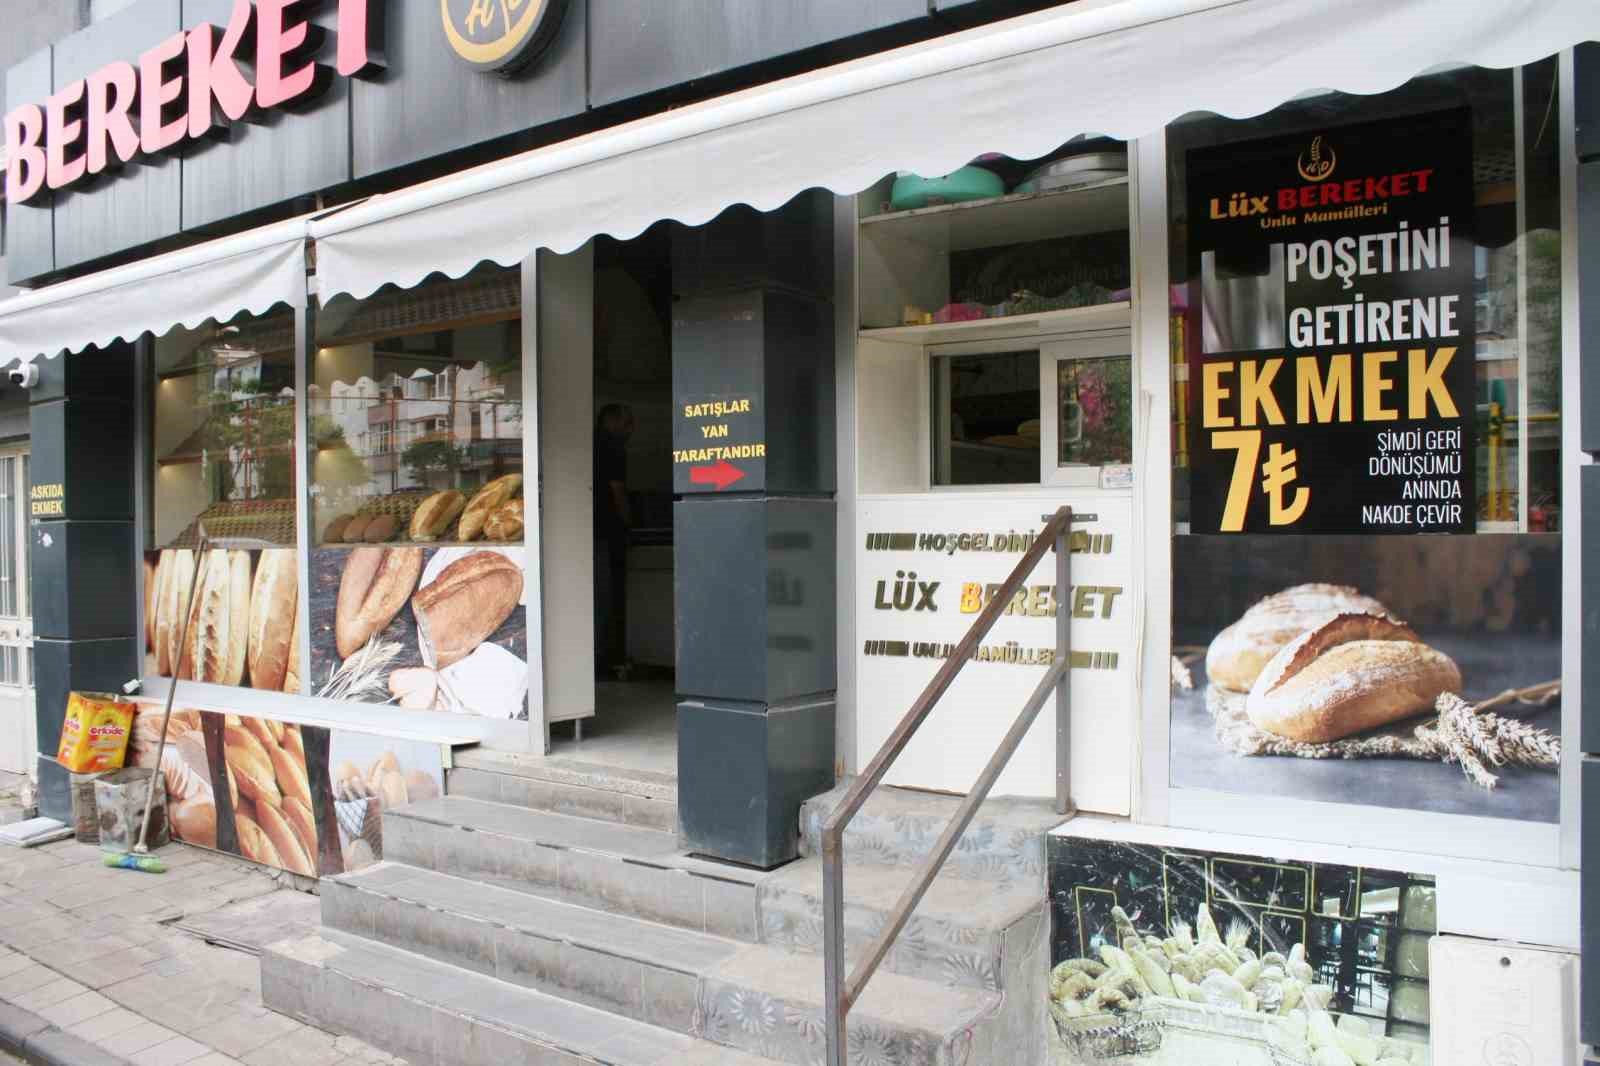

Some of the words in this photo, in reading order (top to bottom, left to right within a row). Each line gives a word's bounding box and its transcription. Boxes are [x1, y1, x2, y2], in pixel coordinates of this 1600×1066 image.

[1209, 192, 1269, 219] Lüx
[1277, 168, 1433, 211] BEREKET
[1260, 214, 1297, 229] Unlu
[1303, 202, 1388, 225] Mamülleri
[1287, 216, 1450, 289] POŞETİNİ
[1289, 293, 1460, 348] GETİRENE
[1202, 347, 1460, 428] EKMEK
[685, 400, 750, 418] SATIŞLAR
[702, 424, 728, 438] YAN
[1377, 428, 1421, 454] ŞİMDİ
[1425, 427, 1461, 450] GERİ
[673, 444, 765, 463] TARAFTANDIR
[1369, 451, 1461, 478] DÖNÜŞÜMÜ
[1402, 480, 1462, 499] ANINDA
[1362, 504, 1412, 525] NAKDE
[1417, 501, 1461, 527] ÇEVİR
[918, 529, 1044, 555] HOŞGELDİNİ
[874, 570, 941, 612] LÜX
